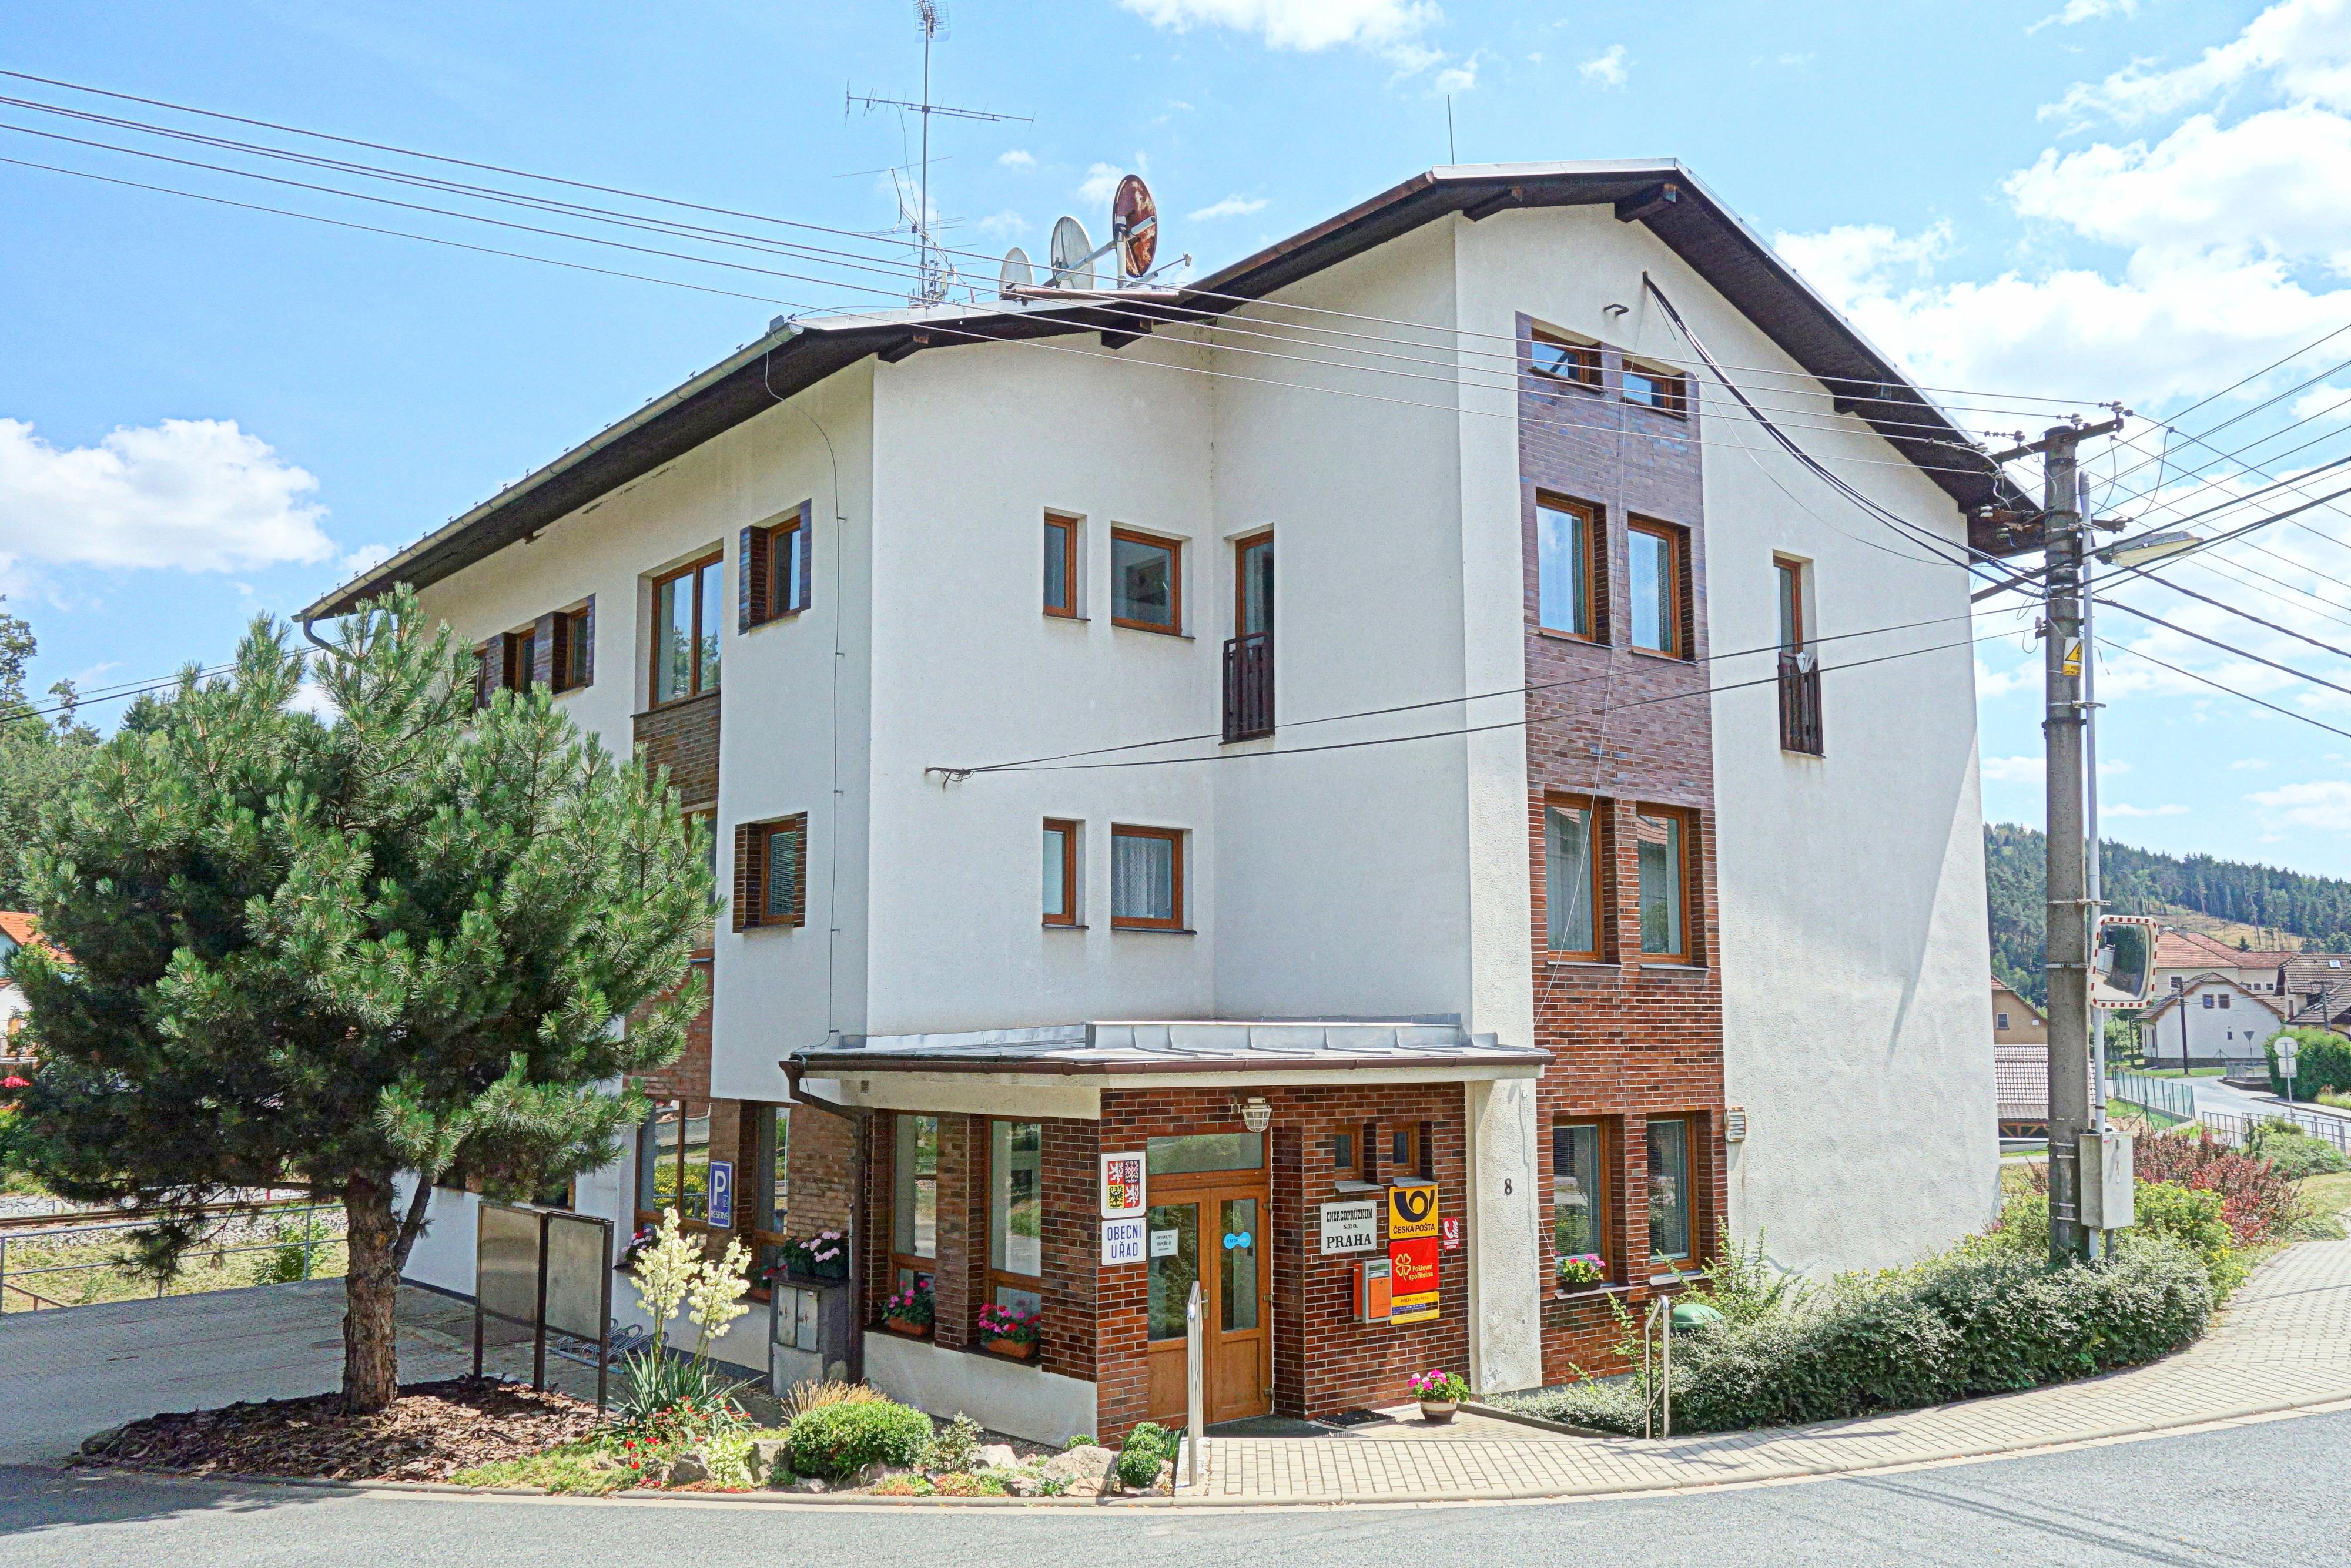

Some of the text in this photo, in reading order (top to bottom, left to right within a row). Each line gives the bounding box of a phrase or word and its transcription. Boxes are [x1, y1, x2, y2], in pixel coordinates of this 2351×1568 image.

[714, 1170, 726, 1205] P
[1505, 1178, 1512, 1195] 8
[1107, 1221, 1141, 1241] OBECNÍ
[1393, 1222, 1435, 1234] ČESKÁ POŠTA
[1326, 1234, 1372, 1249] PRAHA
[1111, 1241, 1138, 1259] ÚŘAD
[1412, 1263, 1433, 1272] Poštovní
[1409, 1271, 1434, 1281] spořitelna
